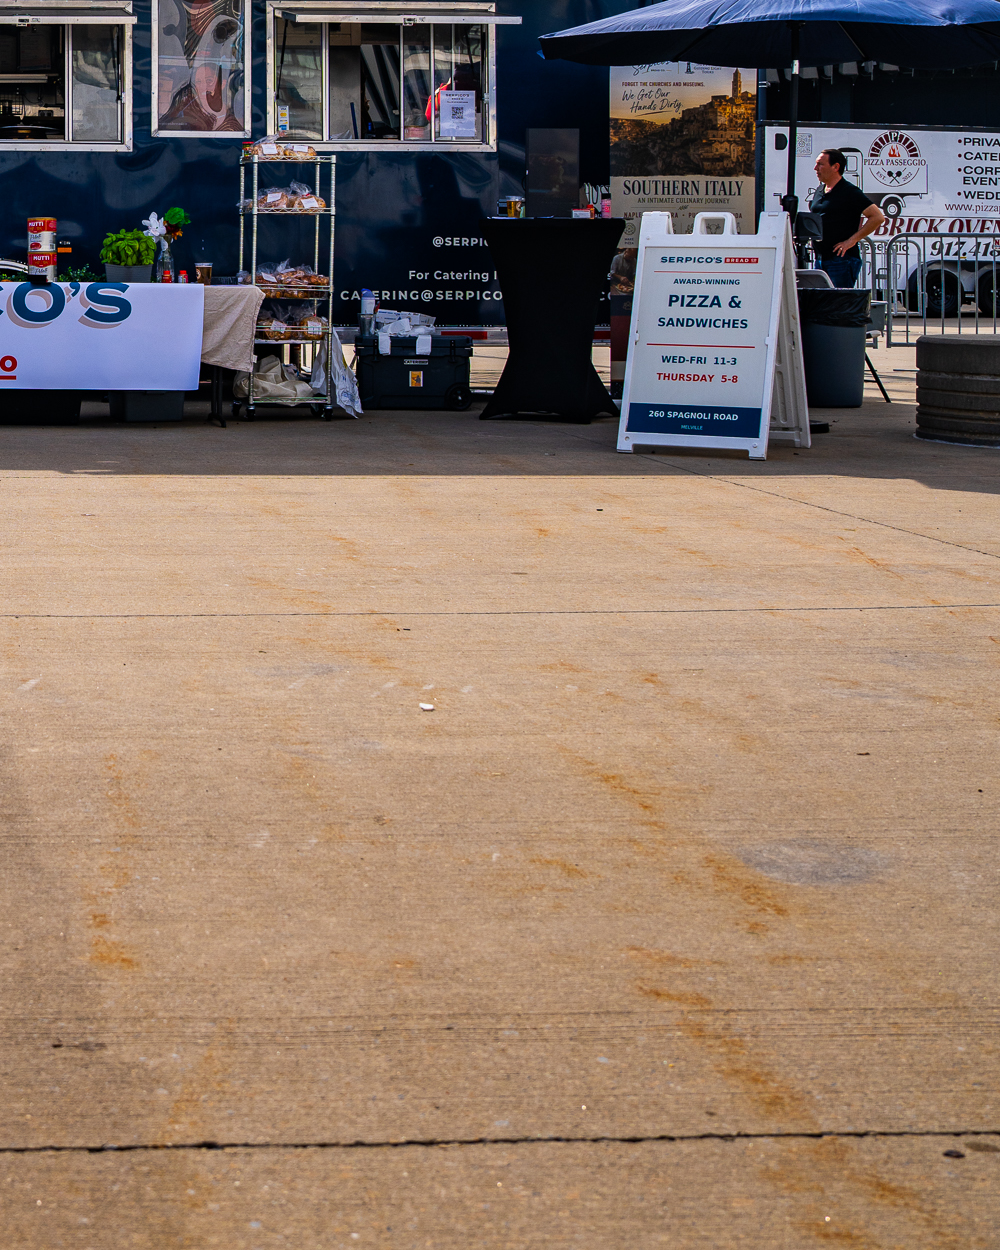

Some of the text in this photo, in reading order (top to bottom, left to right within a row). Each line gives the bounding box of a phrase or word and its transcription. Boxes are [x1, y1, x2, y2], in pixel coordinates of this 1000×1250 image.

[622, 88, 671, 101] We Get Our
[630, 100, 657, 113] Hands
[891, 132, 898, 141] P
[963, 151, 1000, 161] CATE
[864, 158, 926, 166] PIZZA PASSEGGIO
[875, 170, 886, 181] EST.
[623, 179, 744, 197] SOUTHERN ITALY
[945, 202, 1000, 214] www.pizza
[873, 217, 946, 236] BRICK
[660, 256, 723, 264] SERPICO'S
[408, 270, 429, 280] For
[434, 269, 489, 282] Catering
[673, 278, 741, 286] AWARD-WINNING
[340, 289, 503, 302] CAERING@SERPICO
[668, 294, 742, 308] PIZZA &
[657, 317, 748, 329] SANDWICHES
[661, 355, 737, 365] WED-FRI 11-3
[656, 372, 738, 383] THURSDAY 5-8
[648, 410, 739, 421] 260 SPAGNOLI ROAD
